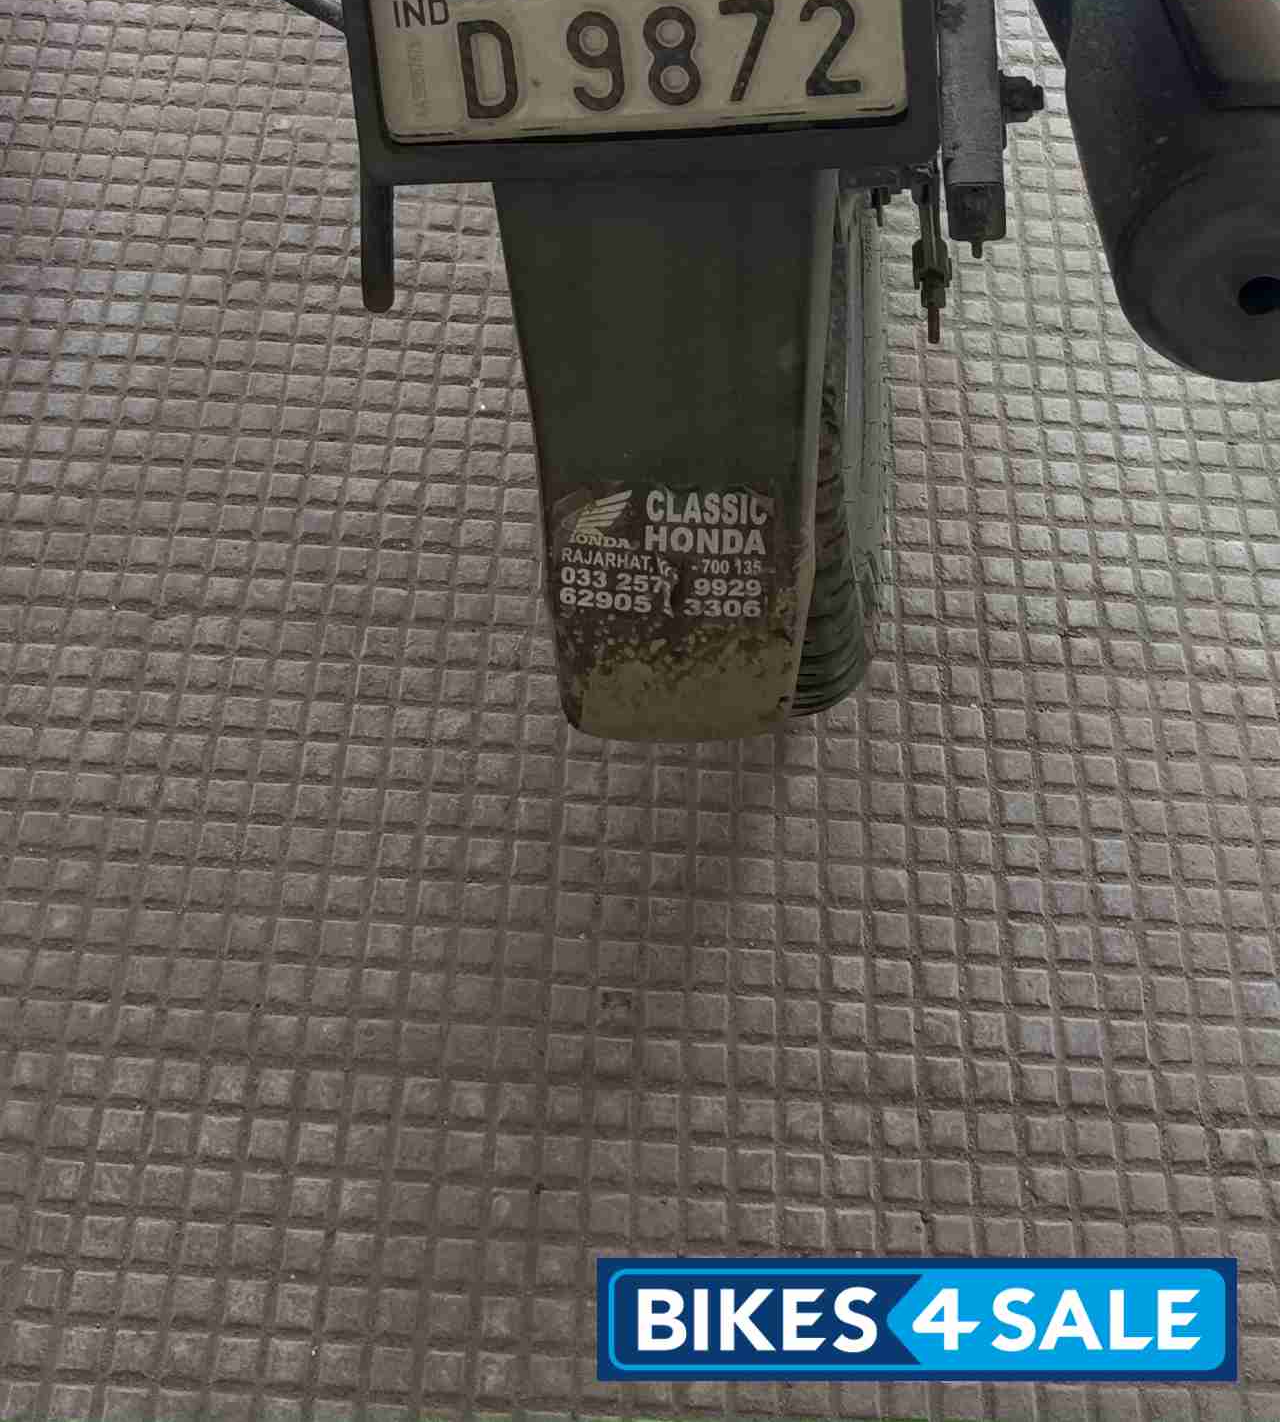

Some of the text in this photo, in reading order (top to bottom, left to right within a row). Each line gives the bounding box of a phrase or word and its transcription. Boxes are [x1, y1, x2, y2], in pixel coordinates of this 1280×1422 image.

[456, 18, 519, 120] D
[646, 489, 768, 525] CLASSIC
[644, 525, 766, 555] HONDA
[560, 566, 608, 588] 033
[693, 579, 762, 597] 9929
[701, 559, 730, 574] 700
[734, 559, 762, 575] 135
[559, 587, 762, 618] 62905 3306
